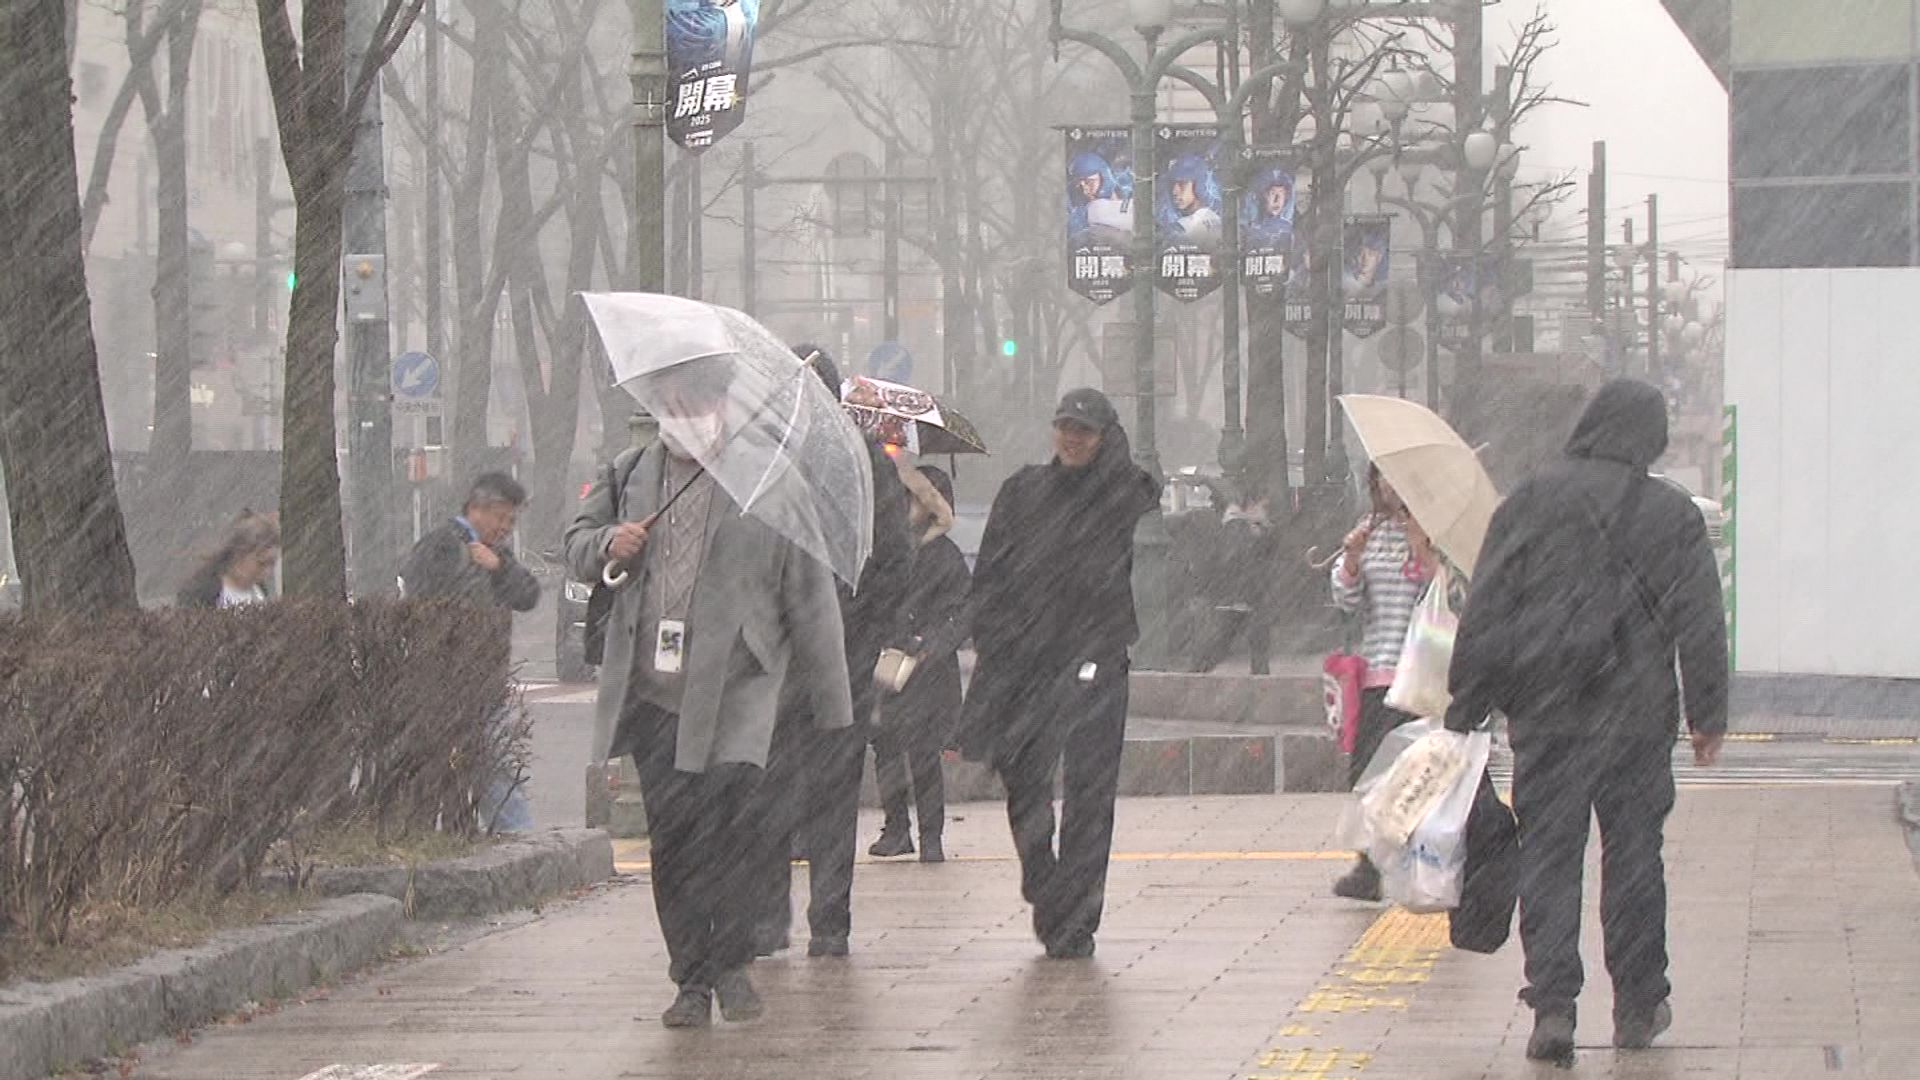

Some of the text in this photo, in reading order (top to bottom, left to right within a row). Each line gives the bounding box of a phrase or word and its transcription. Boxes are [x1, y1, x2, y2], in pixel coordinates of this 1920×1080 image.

[674, 73, 736, 119] 開幕
[1075, 255, 1124, 279] 開幕
[1162, 255, 1210, 278] 開幕
[1246, 255, 1284, 276] 開幕
